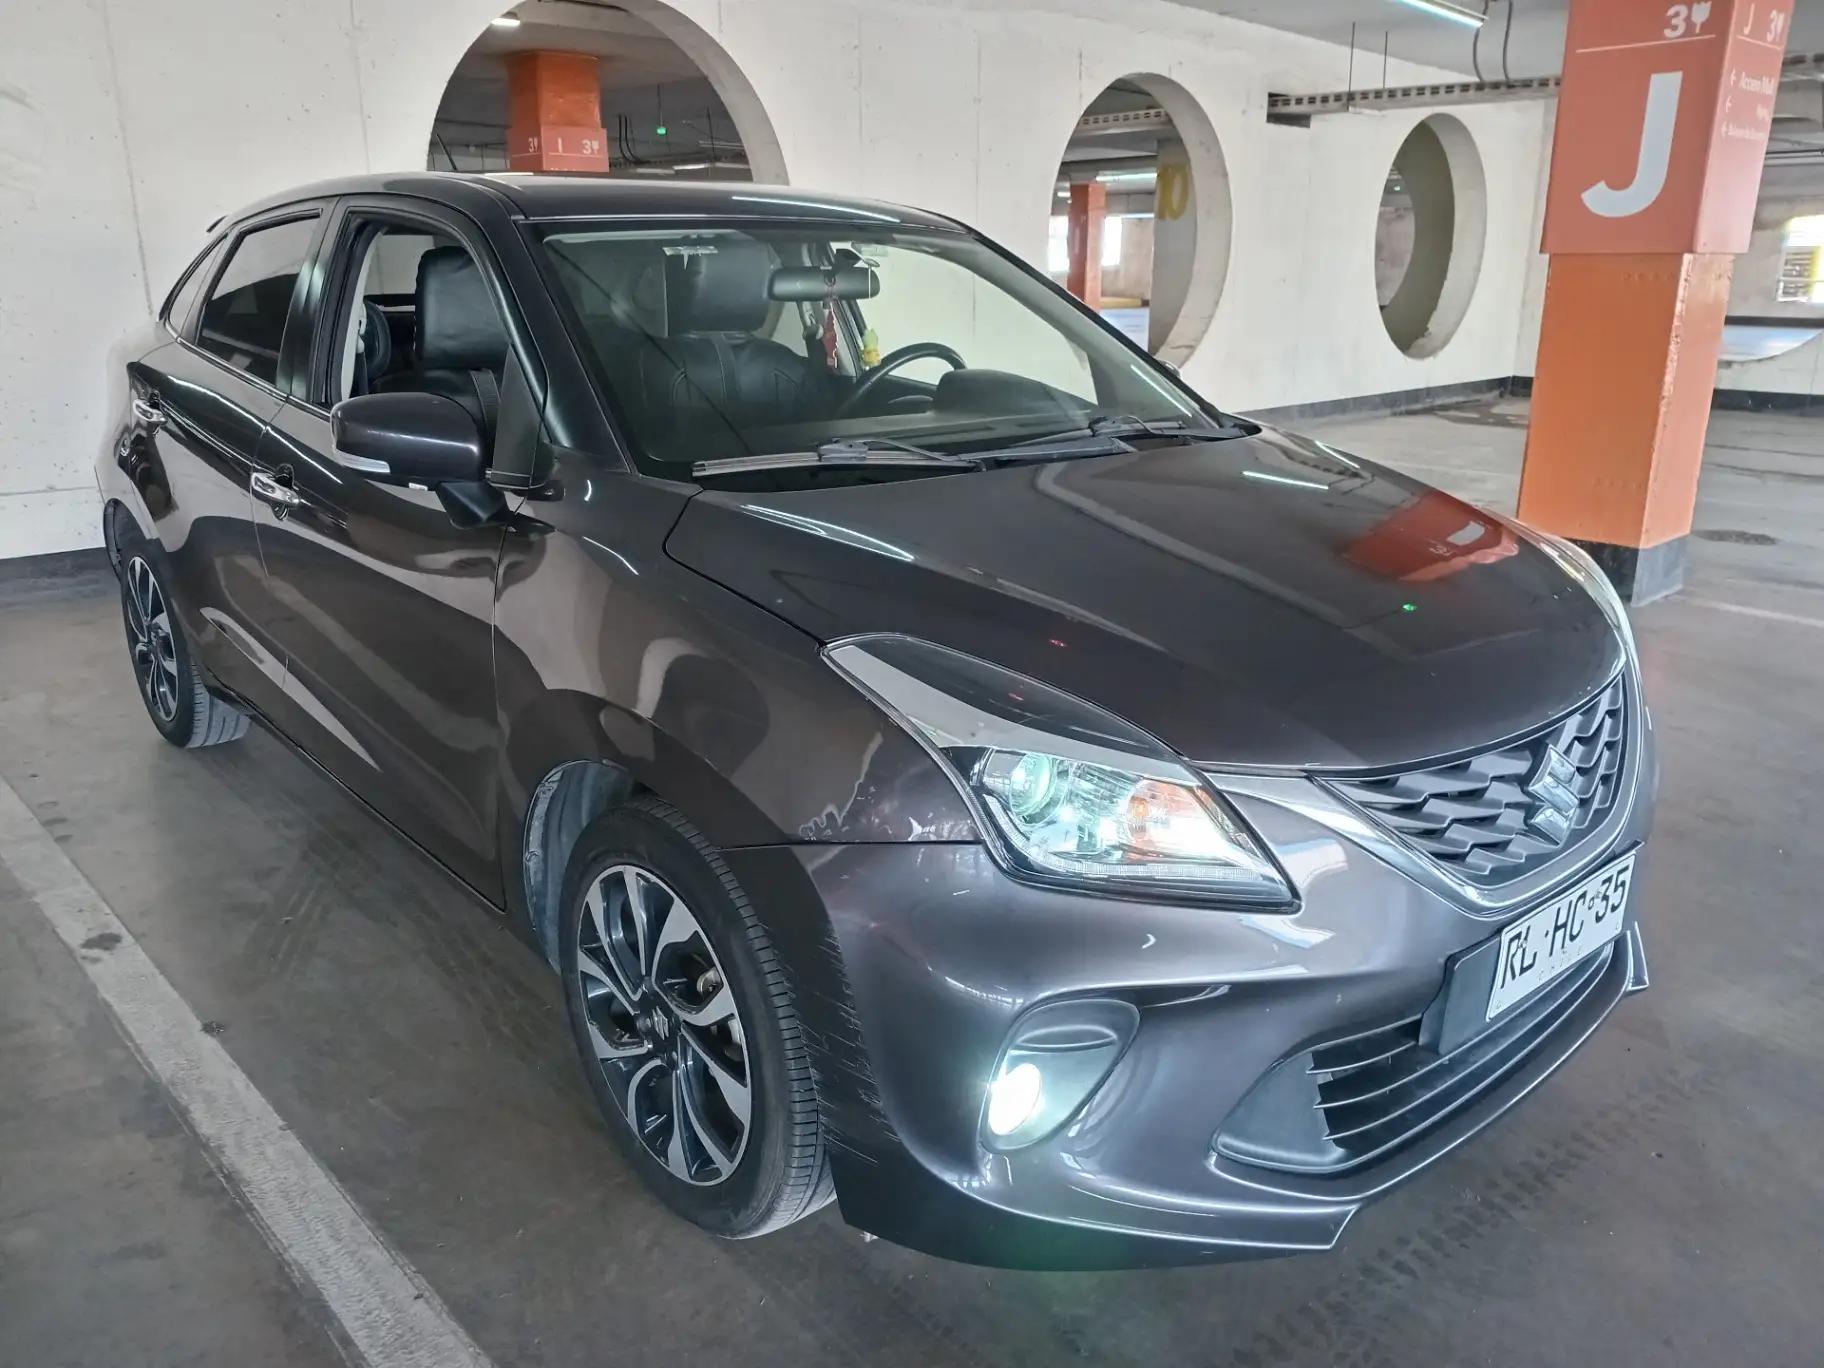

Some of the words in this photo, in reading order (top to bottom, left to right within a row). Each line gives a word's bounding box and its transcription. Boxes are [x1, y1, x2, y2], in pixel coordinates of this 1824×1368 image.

[1663, 4, 1688, 38] 3
[1743, 3, 1756, 36] J
[582, 139, 592, 154] 3
[1581, 70, 1683, 218] J
